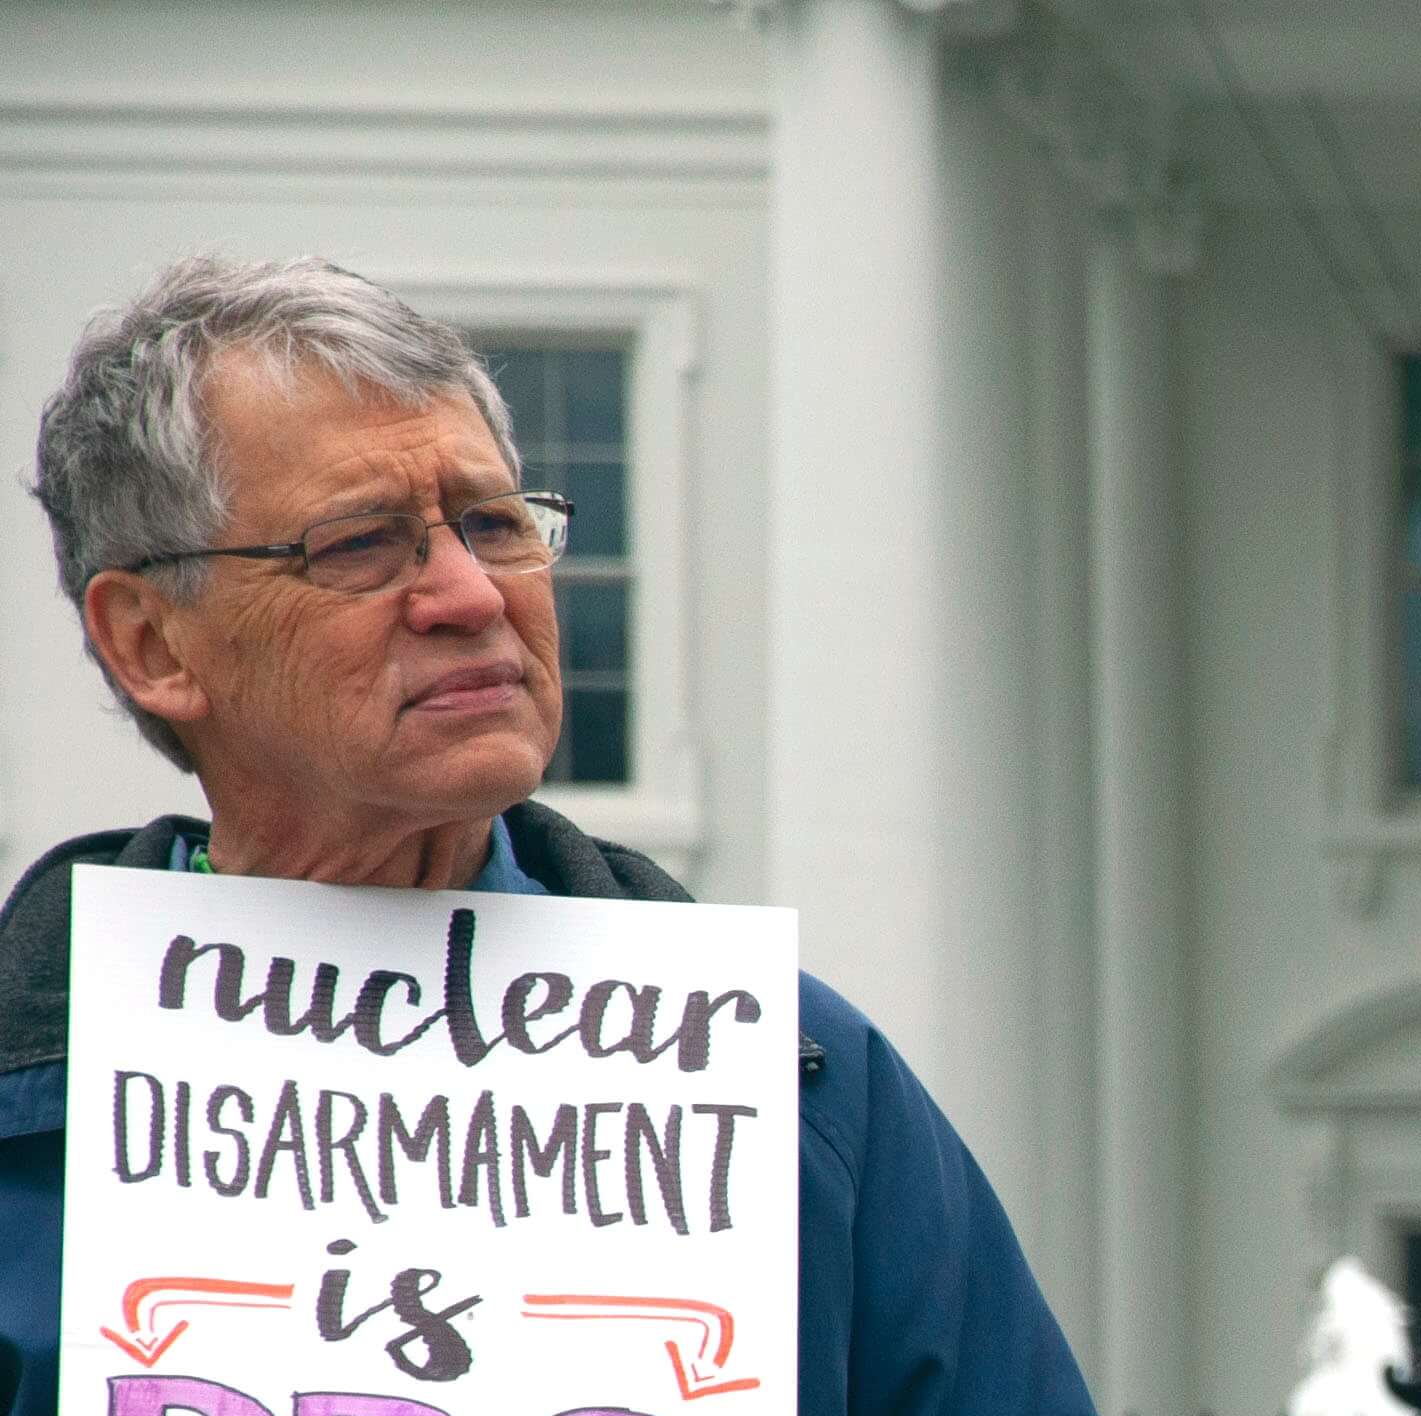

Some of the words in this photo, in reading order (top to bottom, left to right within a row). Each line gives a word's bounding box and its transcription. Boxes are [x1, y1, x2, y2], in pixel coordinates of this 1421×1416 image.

[158, 908, 762, 1072] nuclear
[113, 1071, 757, 1235] DISARMAMENT
[315, 1239, 484, 1381] is
